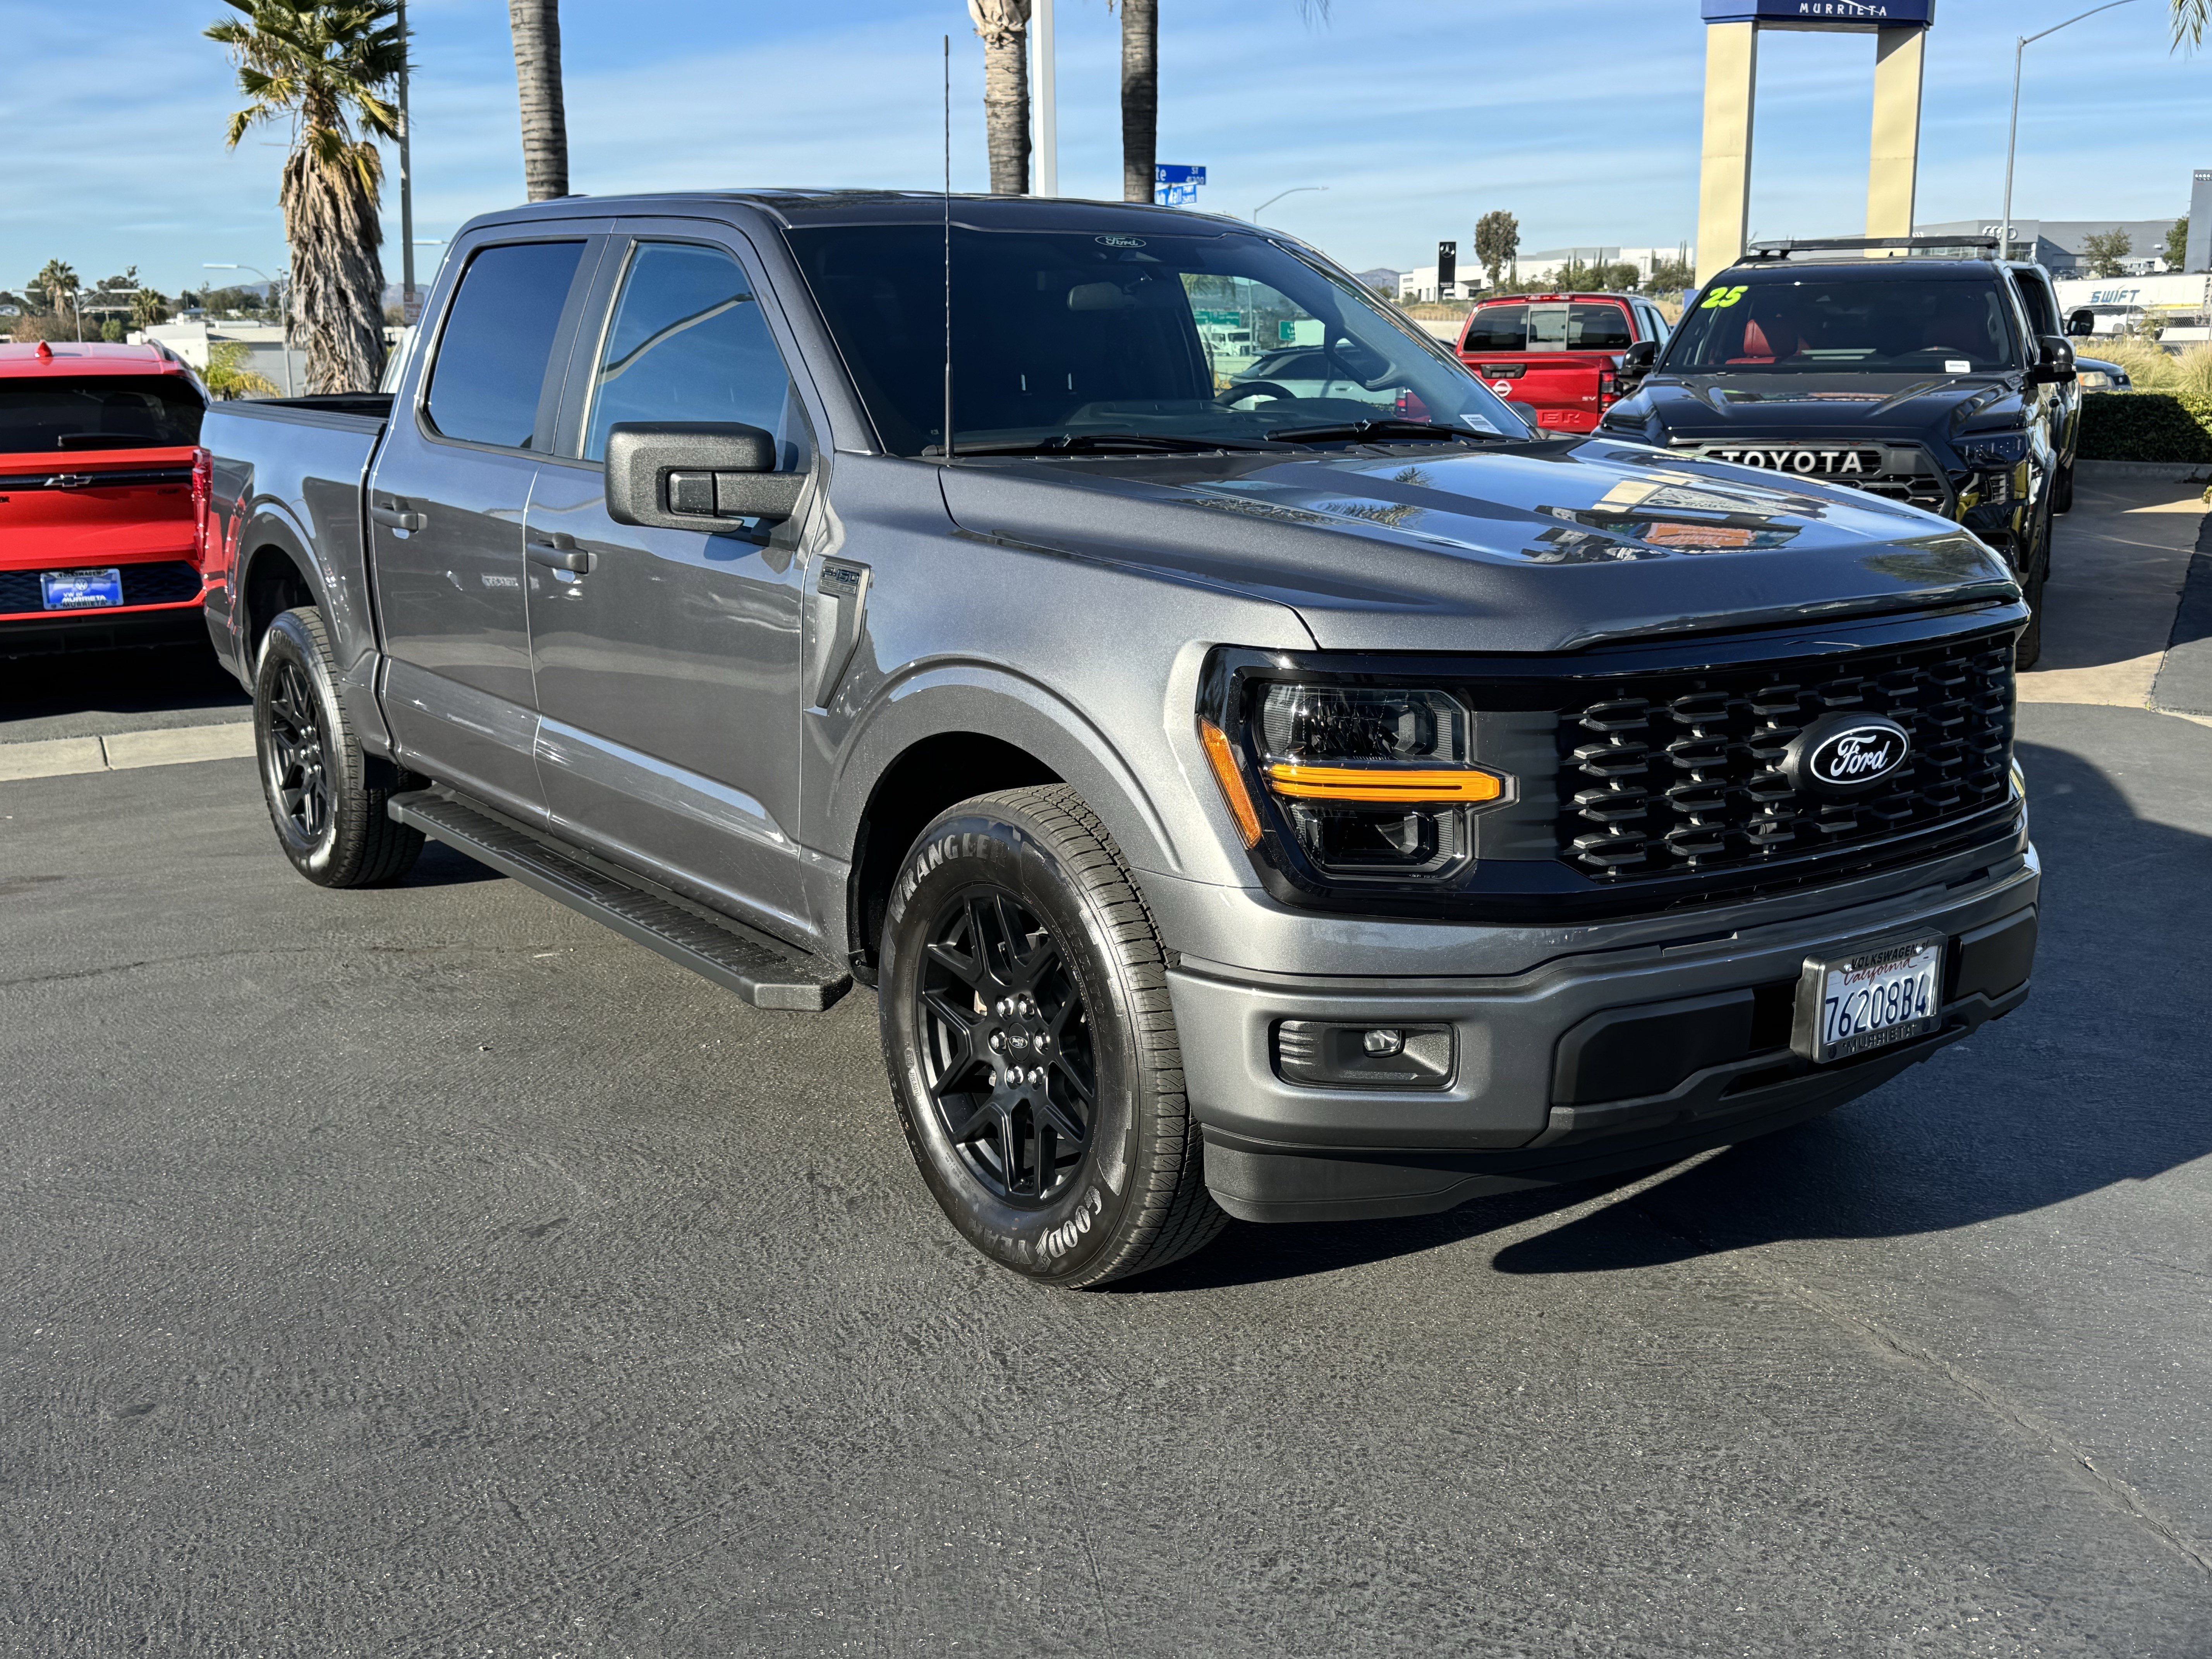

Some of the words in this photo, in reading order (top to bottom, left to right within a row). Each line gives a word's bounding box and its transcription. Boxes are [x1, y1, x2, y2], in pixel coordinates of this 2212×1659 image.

[1799, 3, 1887, 16] MURRIETA
[1155, 166, 1166, 181] te
[1105, 237, 1138, 246] Ford
[1701, 285, 1748, 308] 25
[2090, 289, 2141, 304] SWIFT
[1722, 451, 1863, 473] TOYOTA
[1830, 735, 1891, 776] Ford
[890, 833, 1008, 924] WRANGLER
[1851, 943, 1918, 969] VOLKSWAGEN
[1844, 958, 1918, 986] California
[1825, 974, 1926, 1041] 76208B4
